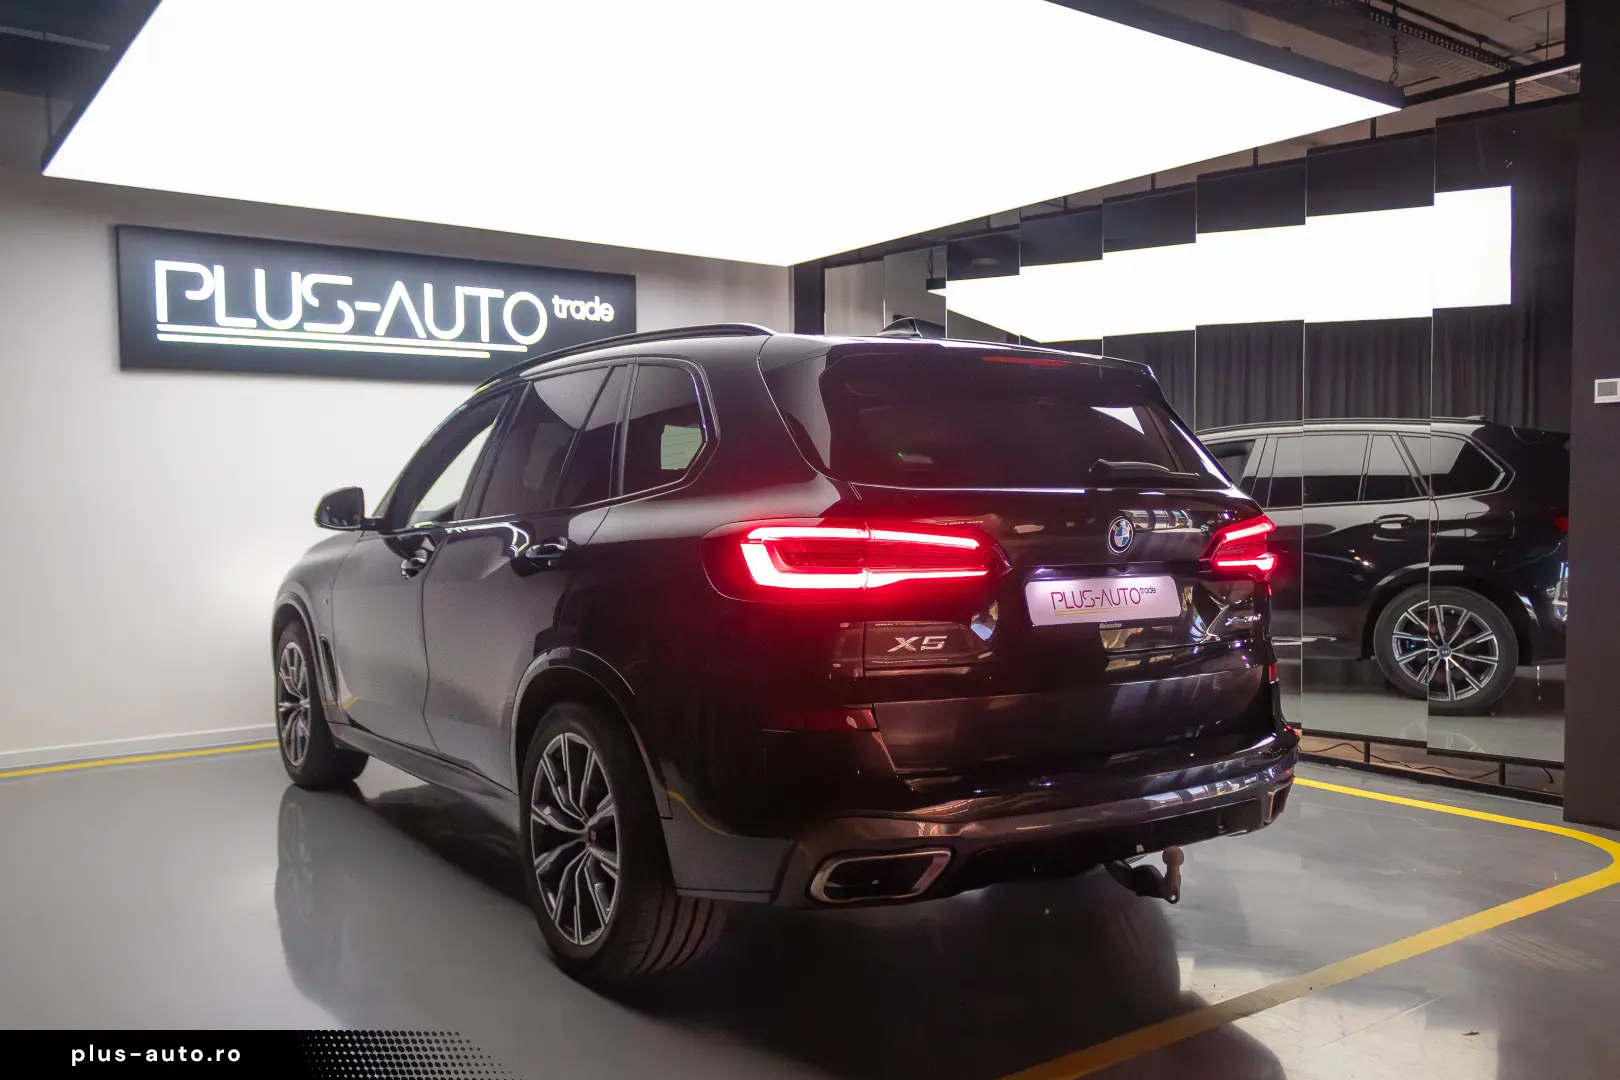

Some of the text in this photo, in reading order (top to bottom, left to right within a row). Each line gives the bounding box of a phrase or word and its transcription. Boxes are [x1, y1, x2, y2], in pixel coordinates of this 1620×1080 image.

[154, 259, 615, 345] PLUS-AUTO trade
[1050, 585, 1157, 610] PLUS-AUTO trade
[886, 635, 948, 653] X5
